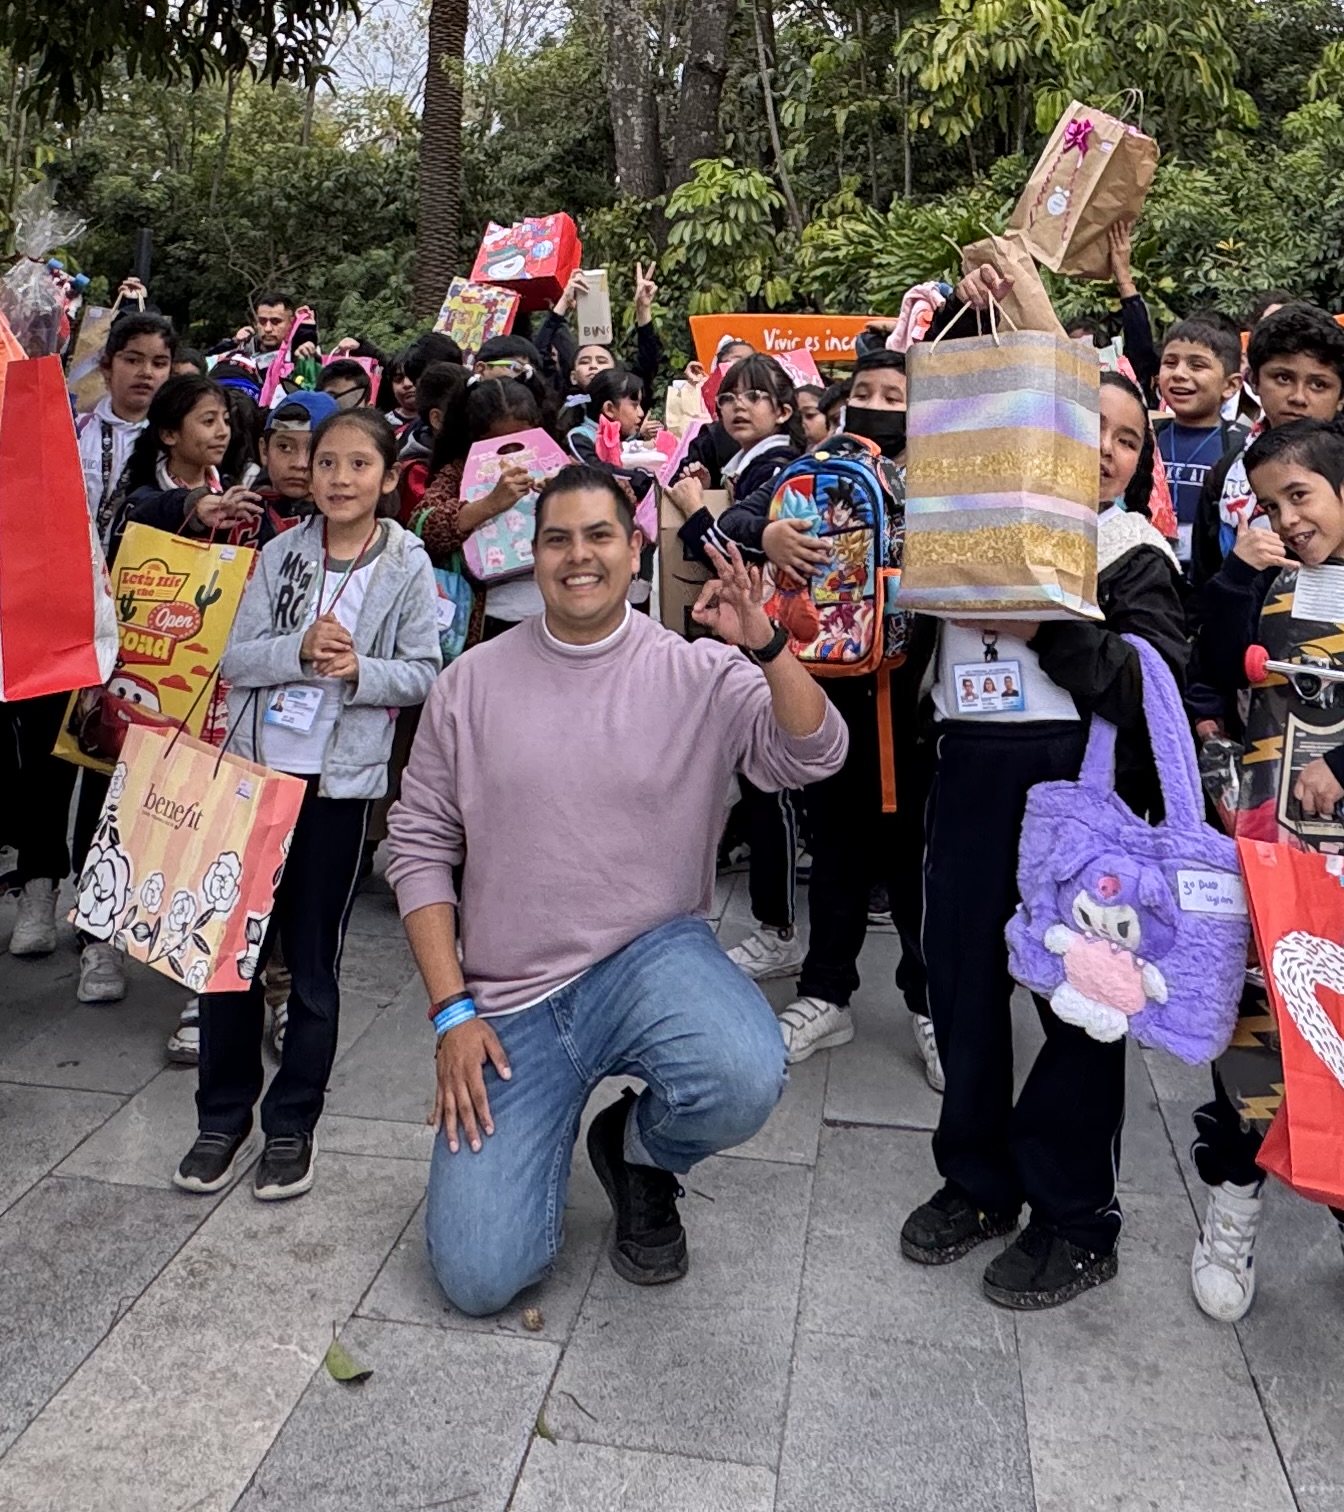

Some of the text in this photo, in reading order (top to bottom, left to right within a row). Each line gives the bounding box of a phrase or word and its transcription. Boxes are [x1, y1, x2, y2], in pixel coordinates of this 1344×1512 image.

[763, 328, 802, 351] Vivir
[805, 335, 821, 352] es
[156, 608, 193, 631] Open
[143, 782, 204, 831] benefit
